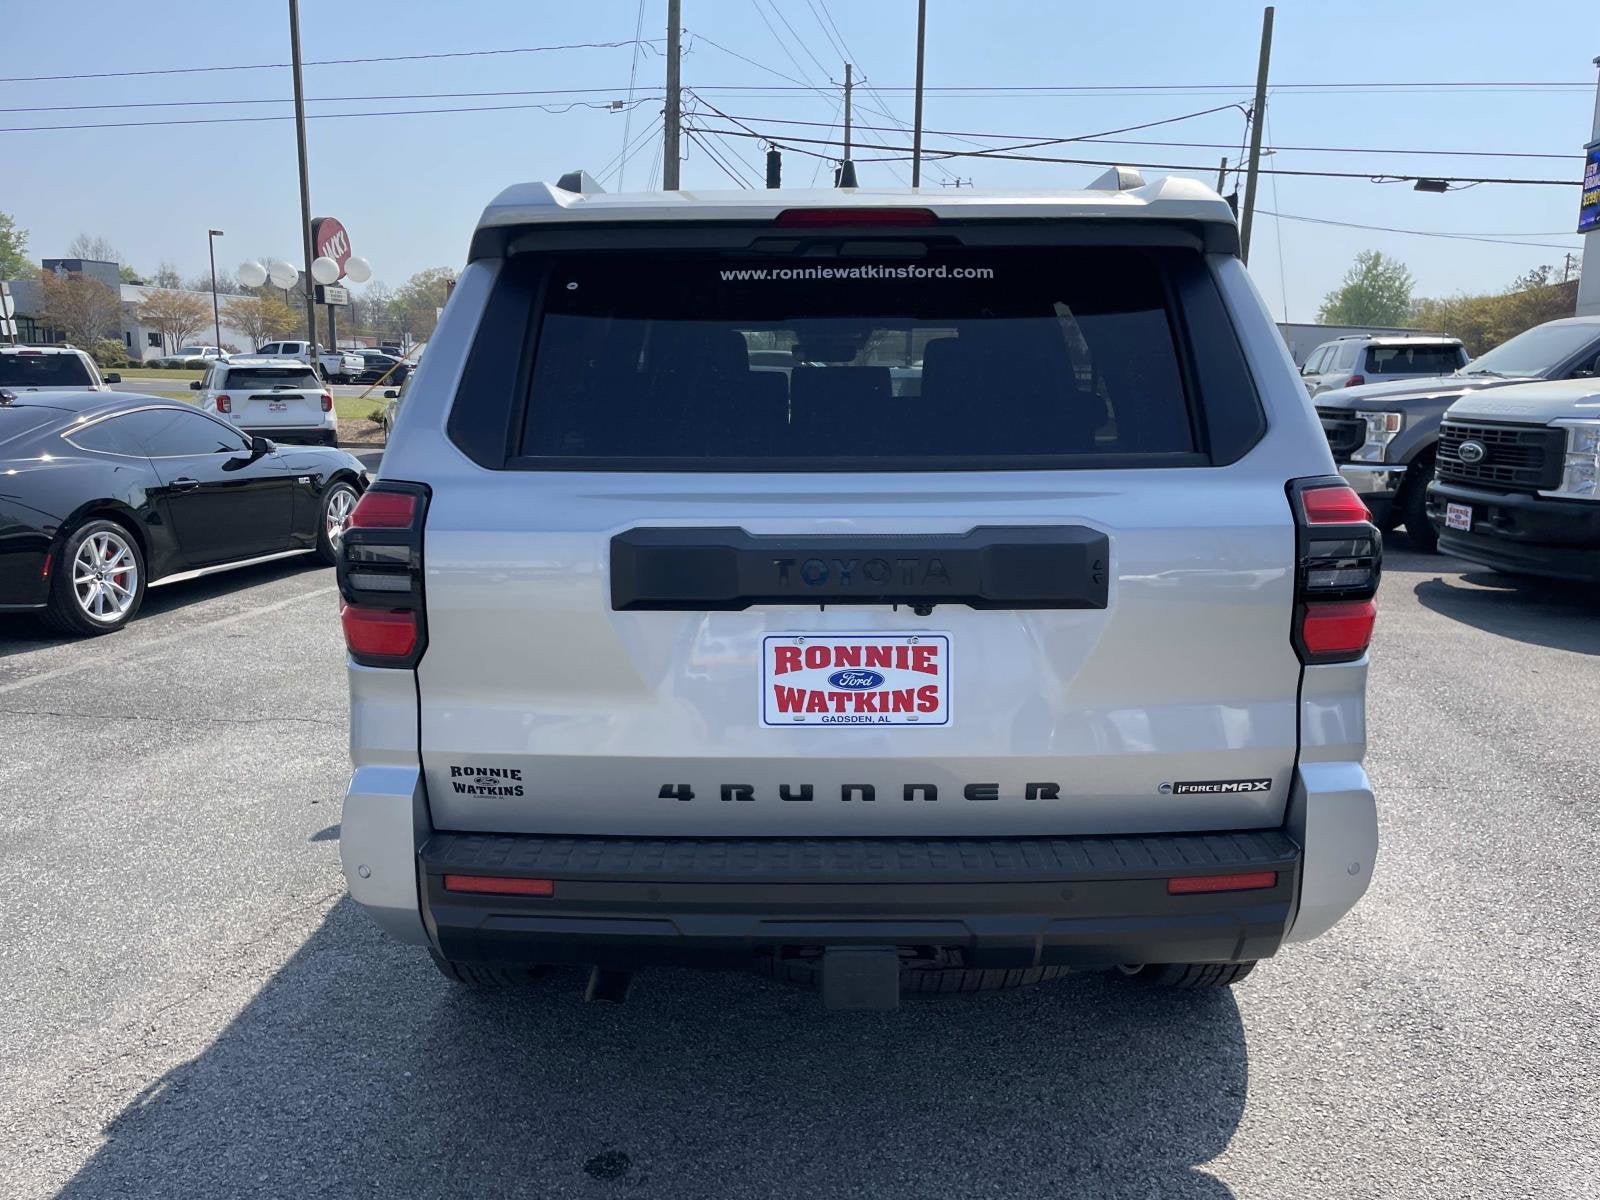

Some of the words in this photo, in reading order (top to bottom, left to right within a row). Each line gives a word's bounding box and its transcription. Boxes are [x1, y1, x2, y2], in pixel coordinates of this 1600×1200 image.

[720, 265, 994, 281] www.ronniewatkinsford.com
[772, 558, 950, 586] TOYOTA
[774, 645, 938, 676] RONNIE
[774, 684, 939, 713] WATKINS
[821, 715, 875, 724] GADSDEN,
[878, 715, 891, 723] AL
[450, 765, 522, 781] RONNIE
[452, 781, 524, 797] WATKINS
[658, 782, 1061, 802] 4RUNNER
